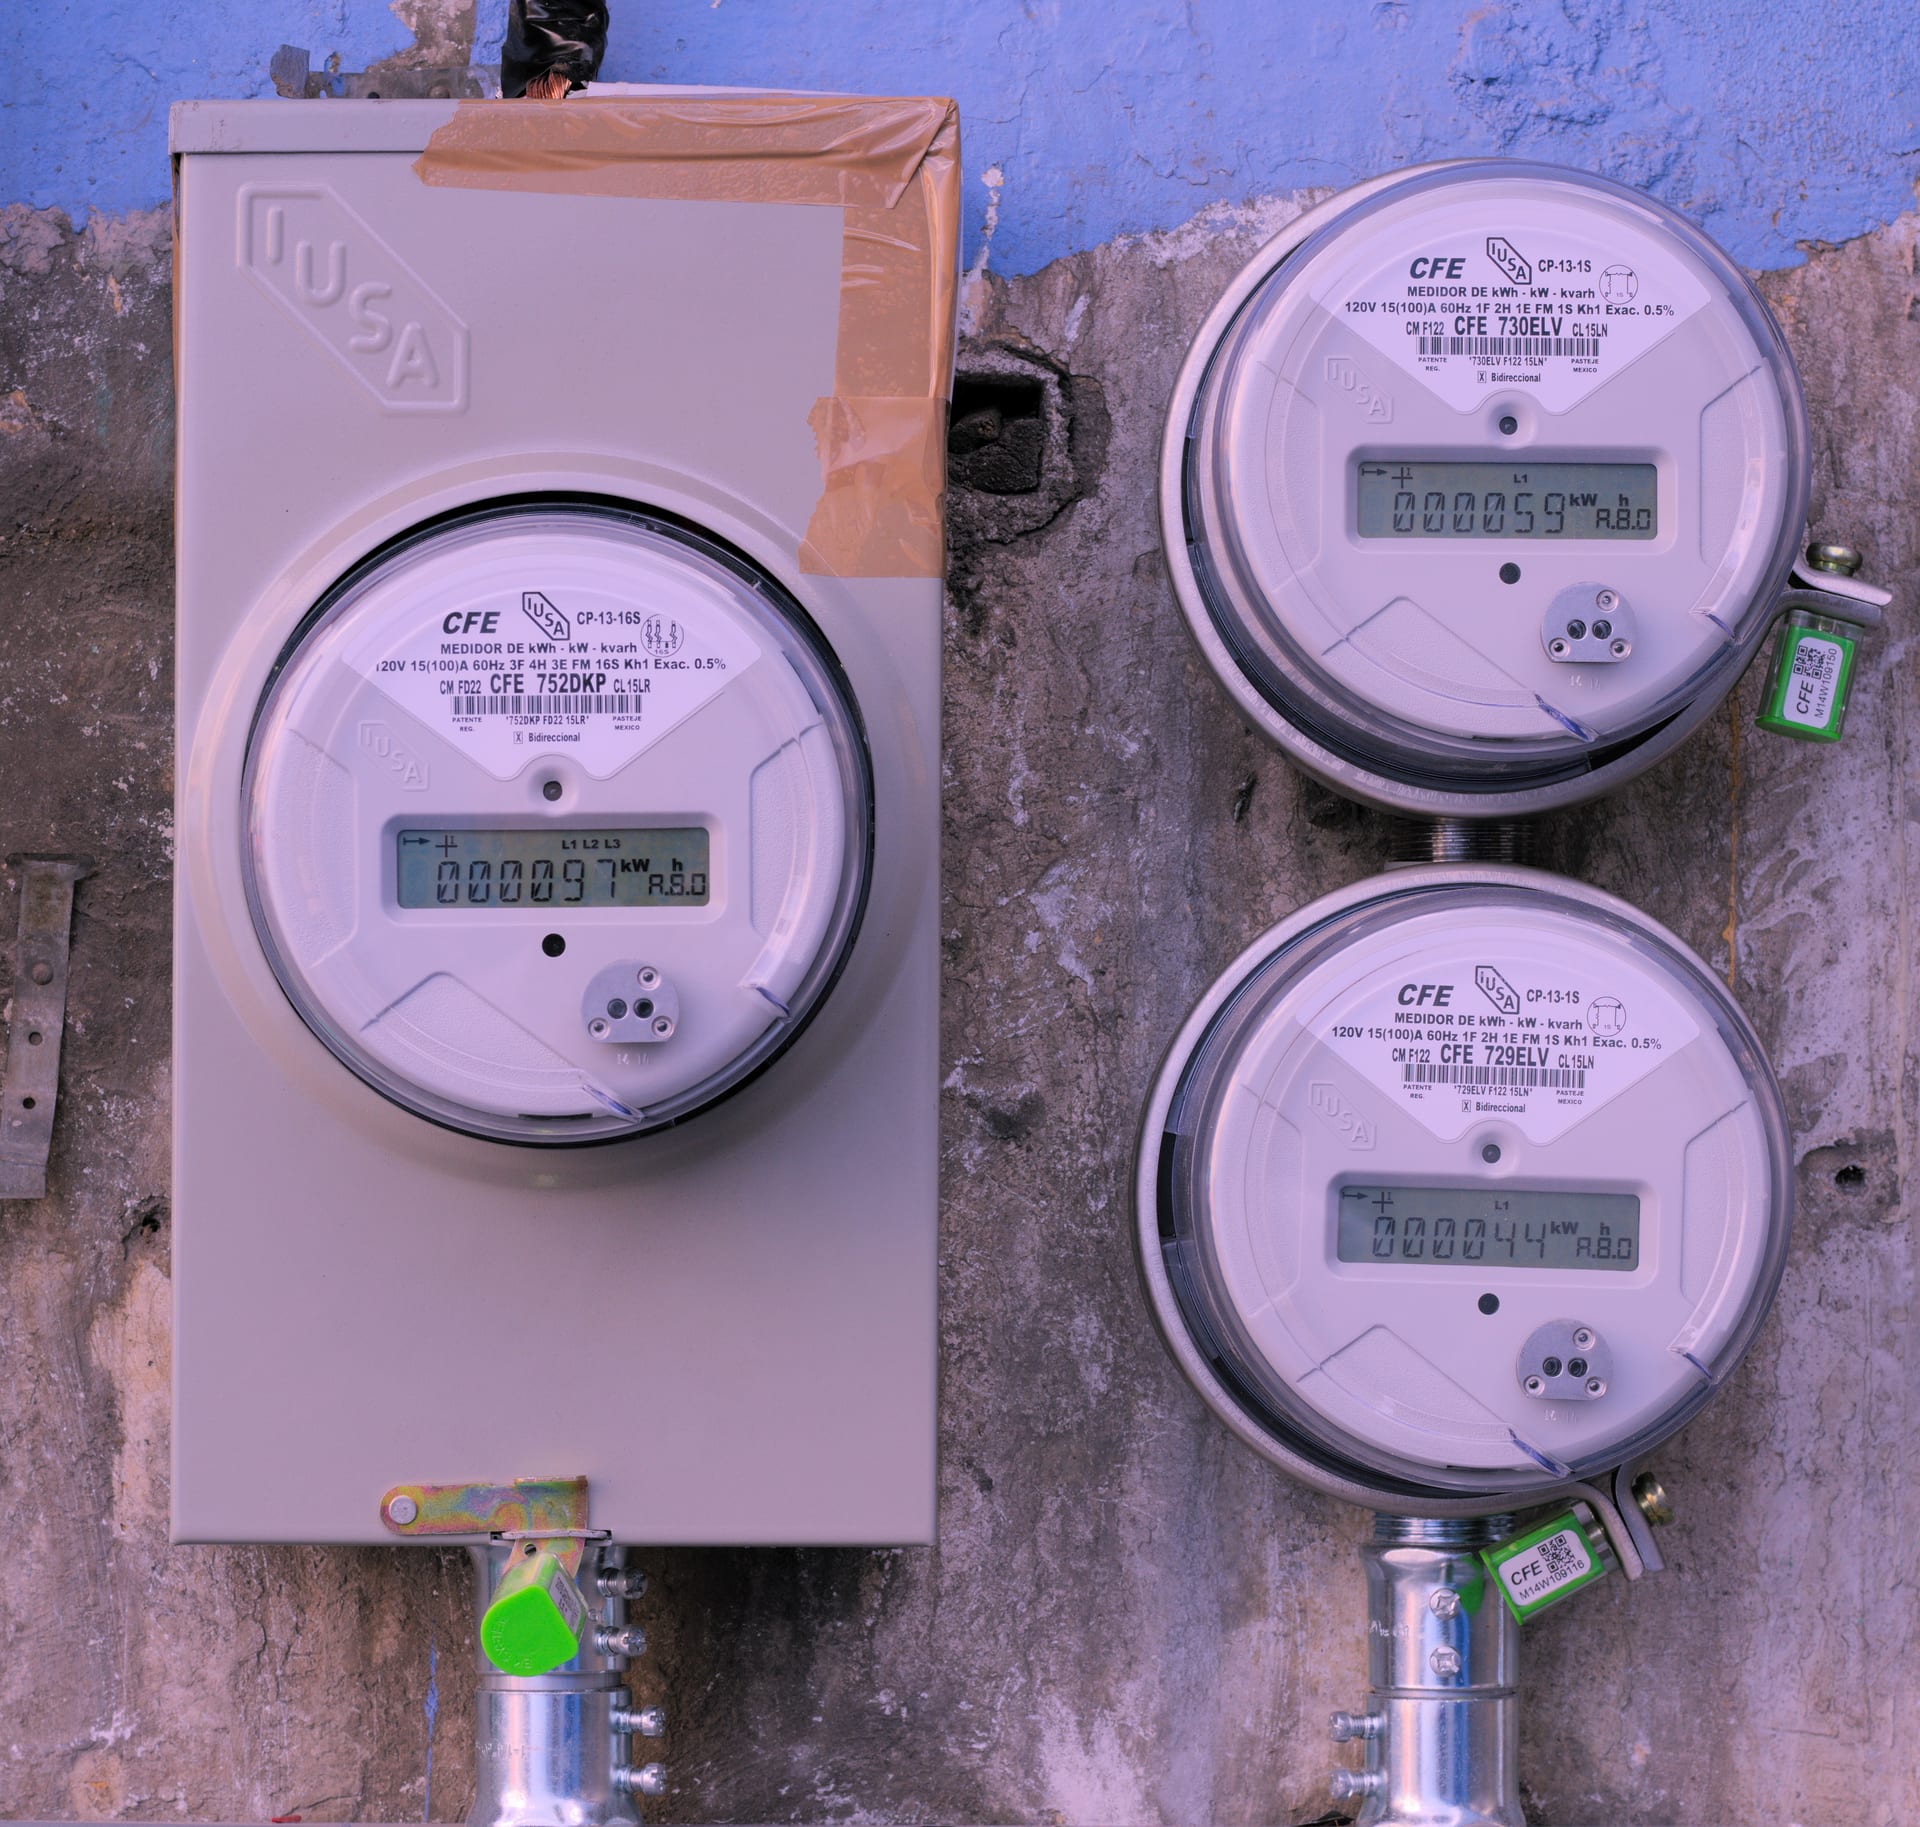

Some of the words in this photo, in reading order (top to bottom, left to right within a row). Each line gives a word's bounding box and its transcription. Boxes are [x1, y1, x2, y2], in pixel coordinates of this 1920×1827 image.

[1410, 258, 1466, 279] CFE
[1491, 242, 1526, 279] IUSA
[1539, 260, 1591, 272] CP-13-1S
[267, 206, 440, 388] IUSA
[1408, 286, 1466, 297] MEDIDOR
[1472, 287, 1487, 297] DE
[1492, 287, 1518, 297] kWh
[1531, 288, 1549, 297] kW
[1561, 288, 1594, 298] kvarh
[1346, 302, 1376, 312] 120V
[1381, 302, 1436, 315] 15(100)A
[1441, 303, 1471, 313] 60Hz
[1476, 303, 1490, 313] 1F
[1495, 303, 1511, 313] 2H
[1516, 303, 1530, 314] 1E
[1536, 304, 1552, 314] FM
[1558, 304, 1572, 314] 1S
[1578, 304, 1599, 314] Kh1
[1606, 305, 1639, 315] Exac.
[1644, 305, 1674, 316] 0.5%
[1406, 322, 1419, 335] CM
[1423, 322, 1444, 335] F122
[1455, 316, 1487, 335] CFE
[1499, 316, 1562, 336] 730ELV
[1573, 323, 1584, 337] CL
[1586, 323, 1607, 337] 15LN
[1504, 357, 1521, 366] F122
[1492, 373, 1540, 382] Bidireccional
[1332, 362, 1386, 416] IUSA
[1514, 474, 1527, 483] L1
[1393, 493, 1565, 533] 000059
[1570, 494, 1597, 506] kW
[1620, 494, 1629, 506] h
[443, 612, 500, 634] CFE
[527, 597, 566, 636] IUSA
[577, 611, 640, 625] CP-13-16S
[441, 643, 502, 654] MEDIDOR
[507, 643, 524, 653] DE
[529, 643, 556, 653] kWh
[569, 643, 588, 653] kW
[601, 642, 637, 653] kvarh
[411, 660, 468, 673] 15(100)A
[473, 660, 504, 670] 60Hz
[510, 660, 524, 670] 3F
[529, 659, 546, 670] 4H
[552, 659, 567, 670] 3E
[573, 659, 590, 669] FM
[596, 659, 619, 669] 16S
[625, 659, 647, 669] Kh1
[655, 659, 689, 669] Exac.
[695, 658, 726, 669] 0.5%
[440, 680, 454, 694] CM
[459, 680, 481, 694] FD22
[491, 674, 524, 694] CFE
[537, 673, 606, 693] 752DKP
[614, 679, 625, 693] CL
[628, 679, 650, 693] 15LR
[1814, 648, 1837, 718] M14W109150
[1797, 681, 1815, 714] CFE
[543, 715, 562, 725] FD22
[529, 733, 580, 742] Bidireccional
[366, 727, 422, 783] IUSA
[562, 840, 576, 849] L1
[583, 839, 599, 849] L2
[605, 839, 620, 848] L3
[437, 860, 615, 902] 000097
[621, 858, 649, 871] kW
[673, 858, 682, 871] h
[1398, 984, 1454, 1006] CFE
[1480, 972, 1515, 1009] IUSA
[1527, 989, 1579, 1004] CP-13-1S
[1395, 1013, 1453, 1025] MEDIDOR
[1459, 1015, 1475, 1025] DE
[1480, 1016, 1505, 1027] kWh
[1518, 1017, 1536, 1028] kW
[1548, 1018, 1582, 1030] kvarh
[1332, 1027, 1363, 1037] 120V
[1368, 1028, 1422, 1042] 15(100)A
[1427, 1030, 1457, 1041] 60Hz
[1463, 1032, 1477, 1042] 1F
[1481, 1032, 1497, 1043] 2H
[1503, 1033, 1517, 1043] 1E
[1523, 1034, 1540, 1044] FM
[1545, 1035, 1559, 1045] 1S
[1564, 1035, 1586, 1046] Kh1
[1593, 1037, 1626, 1048] Exac.
[1632, 1038, 1661, 1049] 0.5%
[1392, 1048, 1405, 1062] CM
[1409, 1049, 1430, 1063] F122
[1441, 1044, 1473, 1064] CFE
[1485, 1045, 1549, 1067] 729ELV
[1559, 1054, 1570, 1068] CL
[1572, 1055, 1594, 1069] 15LN
[1402, 1083, 1433, 1091] PATENTE
[1489, 1086, 1506, 1096] F122
[1555, 1089, 1585, 1097] PASTEJE
[1409, 1092, 1426, 1100] REG.
[1316, 1087, 1368, 1143] IUSA
[1476, 1102, 1525, 1112] Bidireccional
[1495, 1200, 1508, 1210] L1
[1551, 1222, 1579, 1234] kW
[1600, 1222, 1610, 1235] h
[1511, 1560, 1542, 1585] CFE
[1519, 1560, 1584, 1600] M14W109116
